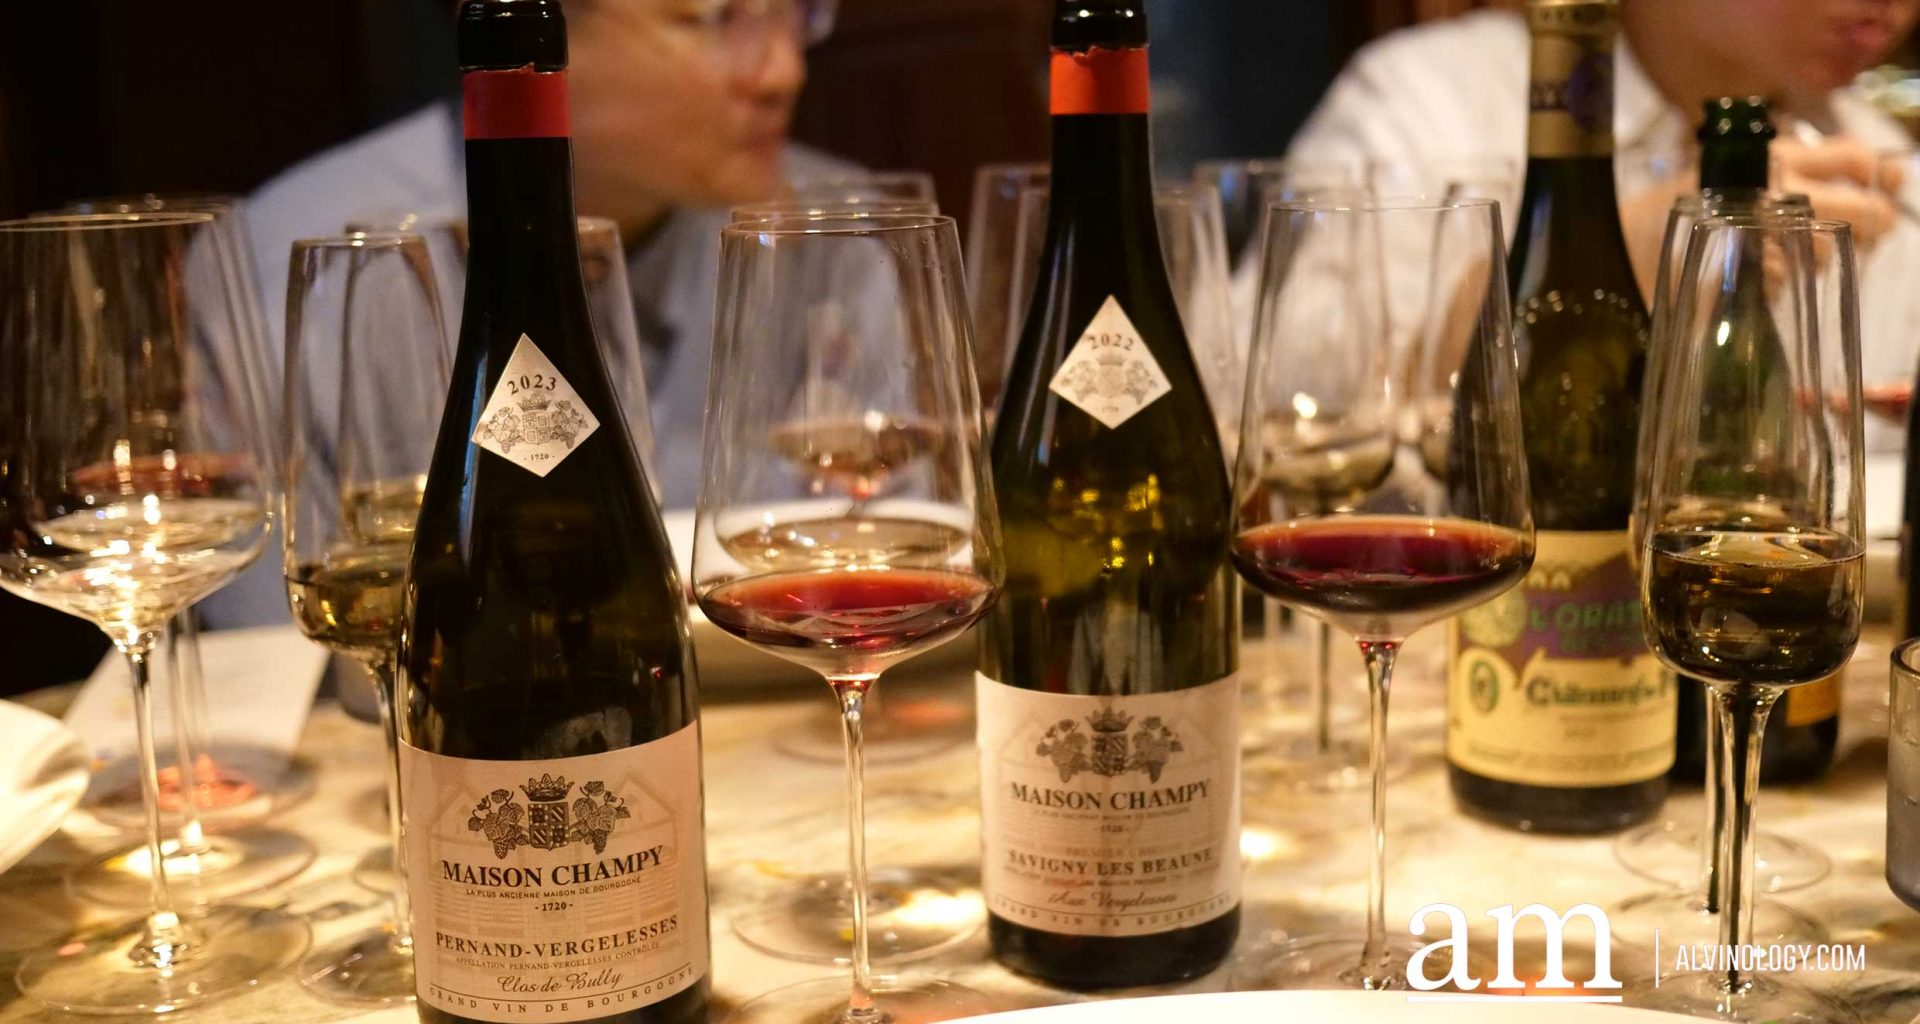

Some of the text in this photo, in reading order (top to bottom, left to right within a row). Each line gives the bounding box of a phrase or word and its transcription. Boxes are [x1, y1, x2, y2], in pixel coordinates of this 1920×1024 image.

[1088, 334, 1134, 351] 2022
[507, 374, 557, 395] 2023
[1011, 778, 1210, 811] MAISON CHAMPY
[441, 845, 664, 888] MAISON CHAMPY
[1009, 848, 1212, 875] SAVIGNY LES BEAUNE
[478, 889, 497, 898] PLUS
[499, 891, 540, 899] ANCIENNE
[544, 889, 576, 898] MAISON
[579, 887, 590, 895] DE
[593, 876, 641, 893] BOURGOGNE
[435, 914, 678, 958] PERNAND-VERGELESSES
[456, 957, 506, 969] APPELLATION
[509, 954, 612, 970] PERNAND-VERGELESSES
[429, 965, 693, 1013] GRAND VIN DE BOURGOGNE
[497, 967, 622, 992] Clos de Bully
